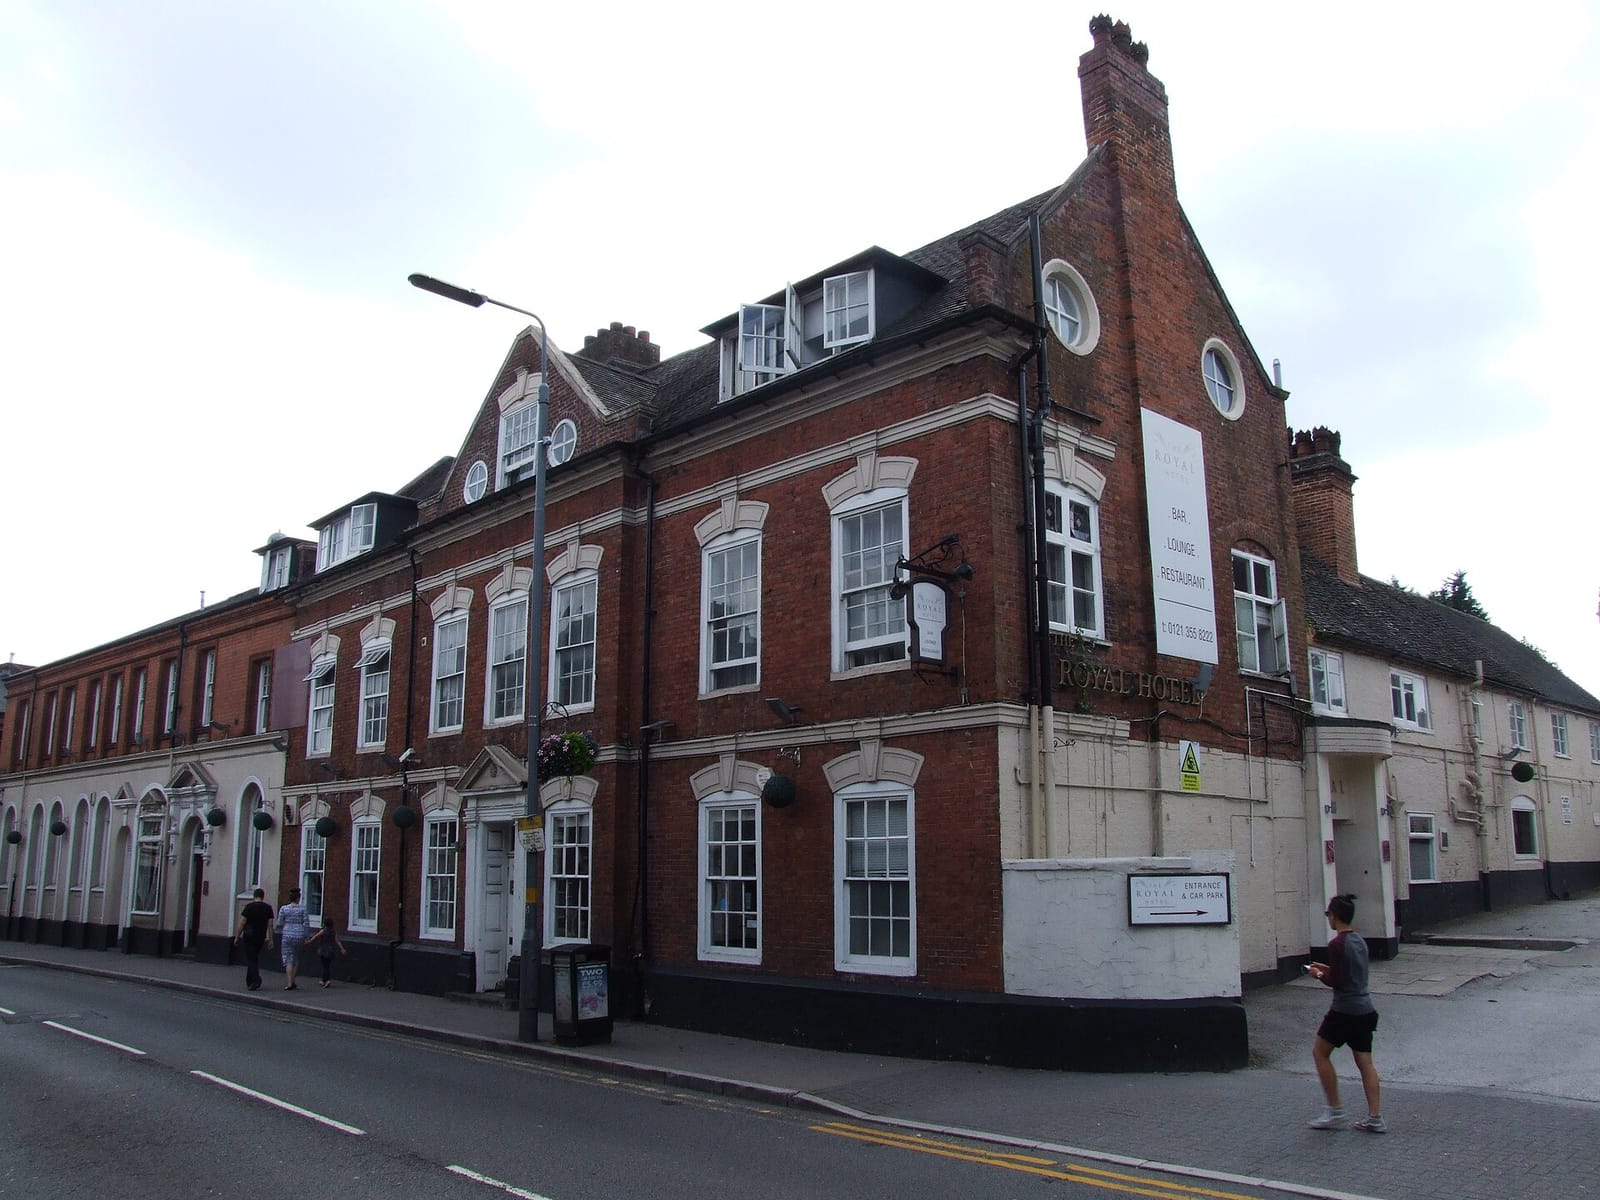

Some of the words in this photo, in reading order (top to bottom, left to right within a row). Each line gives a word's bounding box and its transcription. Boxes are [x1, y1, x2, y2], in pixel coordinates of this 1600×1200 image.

[1154, 448, 1195, 474] ROYAL
[1171, 507, 1187, 523] BAR
[1167, 537, 1196, 557] LOUNGE
[1160, 566, 1206, 590] RESTAURANT
[1168, 622, 1184, 637] 0121
[1185, 625, 1197, 640] 355
[1198, 628, 1214, 643] 8222
[1058, 659, 1130, 694] ROYAL
[1136, 889, 1175, 898] ROYAL
[1184, 881, 1221, 890] ENTRANCE
[1206, 891, 1224, 899] PARK
[580, 968, 603, 977] TWO
